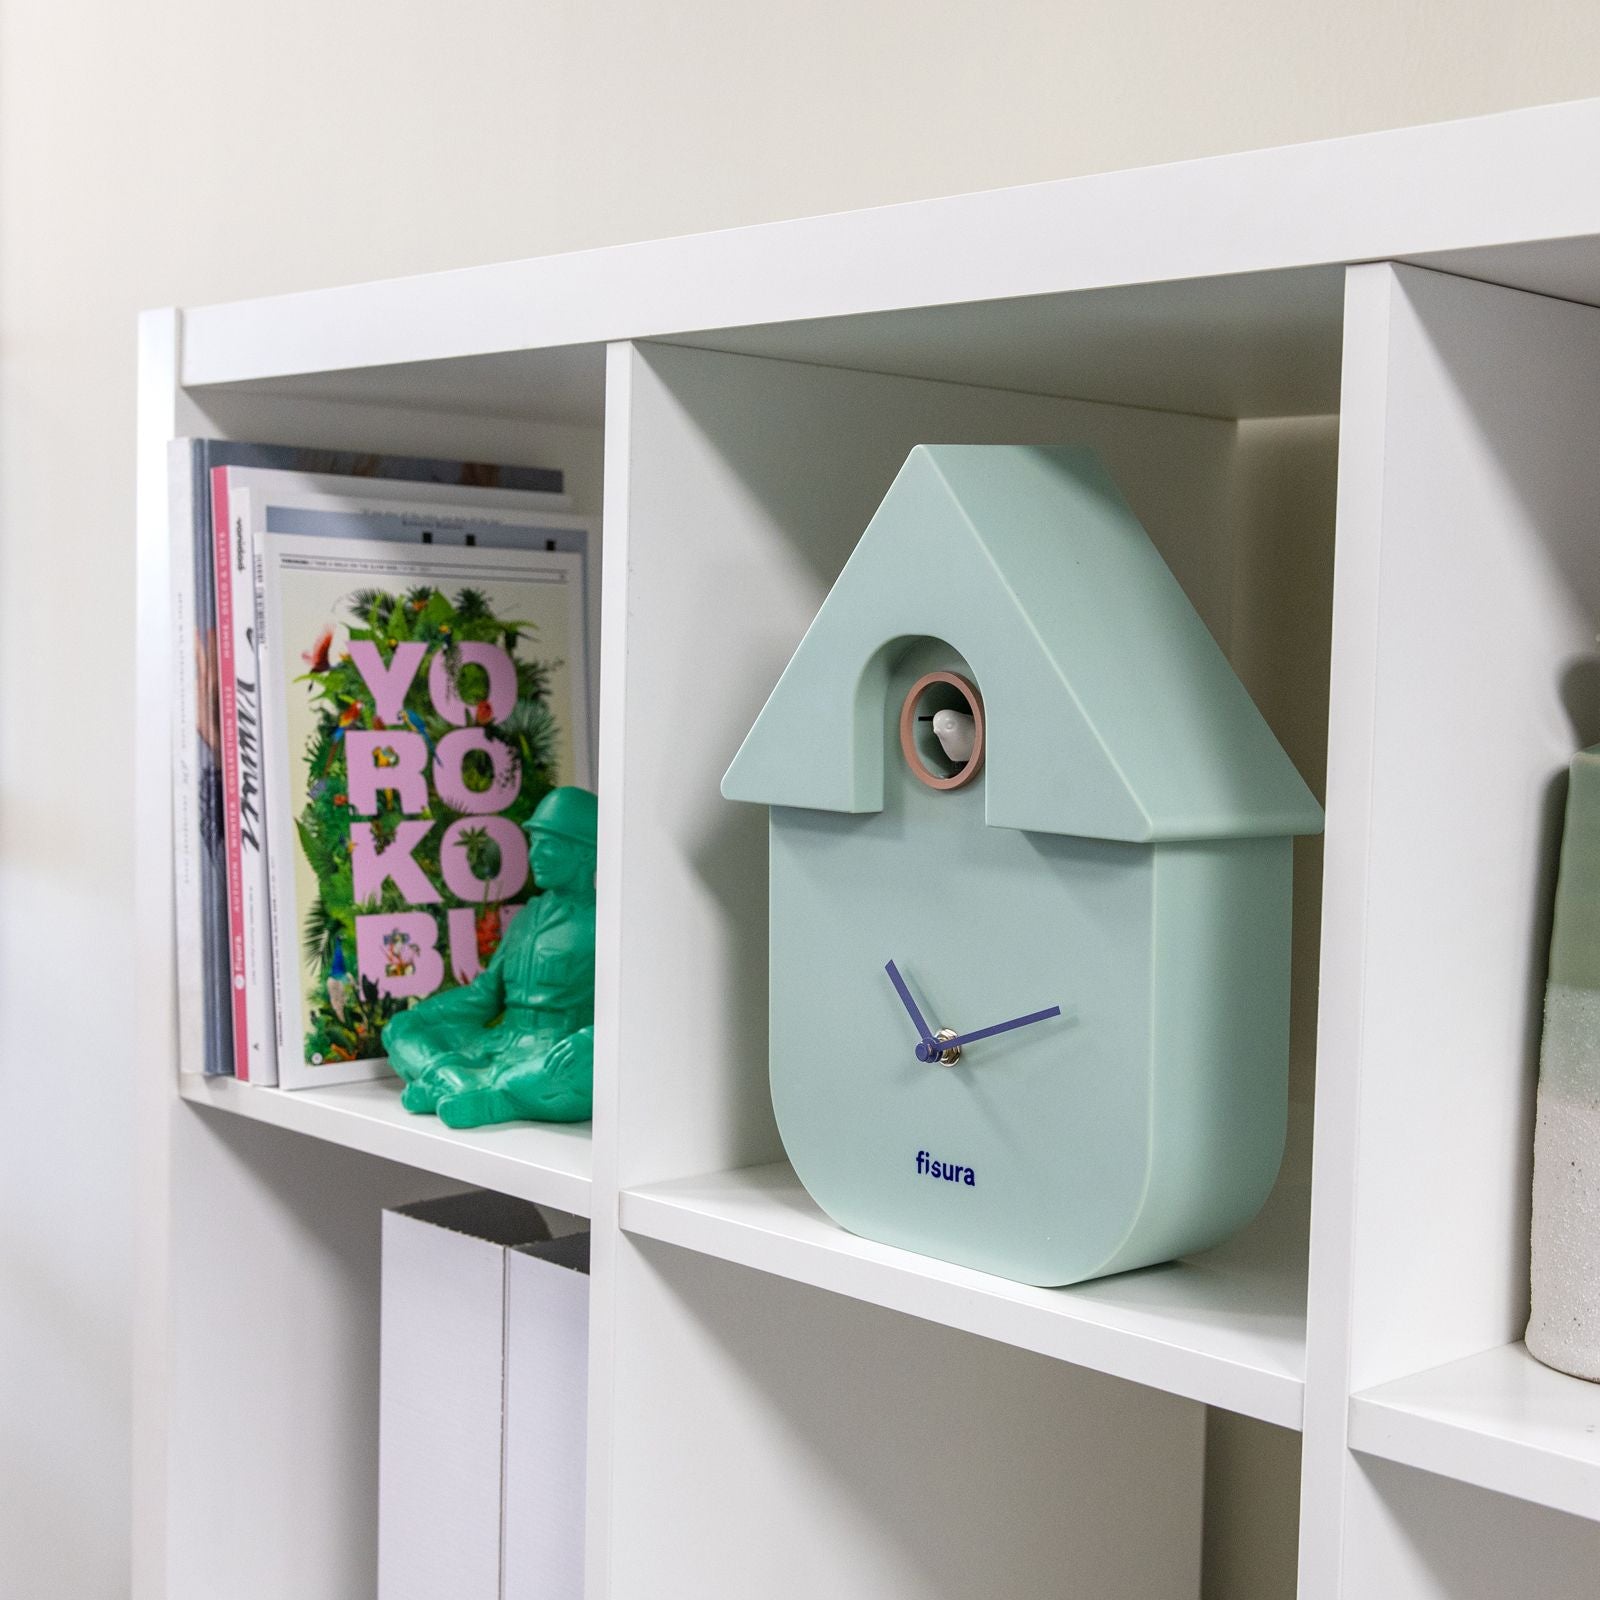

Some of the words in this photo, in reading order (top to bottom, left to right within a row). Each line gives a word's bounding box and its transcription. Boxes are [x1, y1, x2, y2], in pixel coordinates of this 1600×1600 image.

[218, 531, 228, 567] GIFTS
[220, 582, 230, 615] DECO
[345, 640, 518, 727] YO
[225, 718, 237, 795] COLLECTION
[344, 727, 523, 816] RO
[229, 802, 238, 849] WINTER
[350, 815, 529, 905] KO
[232, 861, 241, 913] AUTUMN
[915, 1150, 976, 1187] fisura
